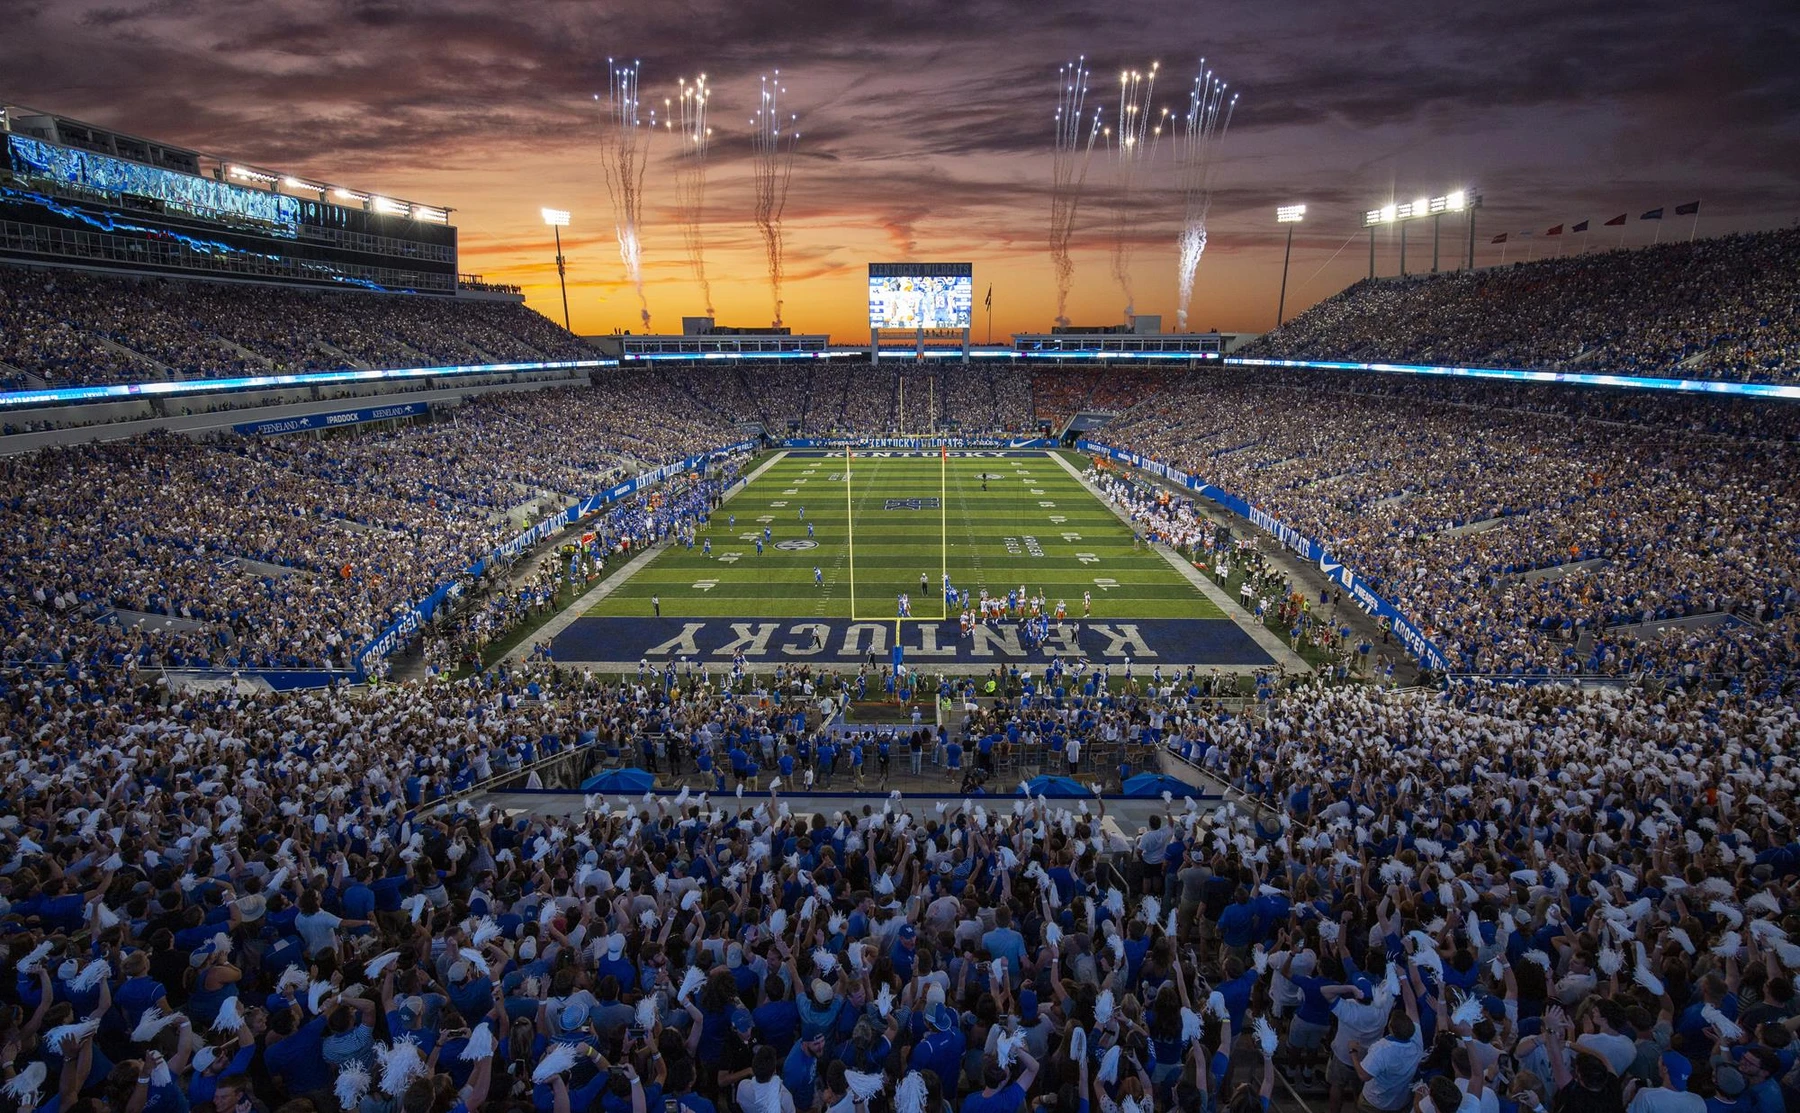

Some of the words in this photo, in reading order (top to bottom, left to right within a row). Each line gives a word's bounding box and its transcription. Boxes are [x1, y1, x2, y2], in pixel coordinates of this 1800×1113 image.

[872, 265, 920, 274] KENTUCKY
[924, 265, 969, 274] WILDCATS
[329, 412, 359, 424] PADDOCK
[372, 408, 403, 418] KEENELAND
[869, 438, 915, 447] KENTUCKY
[921, 438, 964, 447] WILDCATS
[635, 469, 661, 490] KENTUCKY
[662, 461, 685, 478] WILDCATS
[1142, 457, 1165, 475] KENTUCKY
[1166, 466, 1188, 487] WILDCATS
[539, 510, 569, 538] WILDCATS
[1248, 505, 1280, 535] KENTUCKY
[1279, 523, 1311, 558] WILDCATS
[1094, 579, 1120, 587] 10
[361, 631, 397, 666] KROGER
[398, 610, 423, 635] FIELD
[644, 622, 1158, 657] KENTUCKY
[1394, 617, 1425, 655] KROGER
[1427, 648, 1446, 672] FIEL
